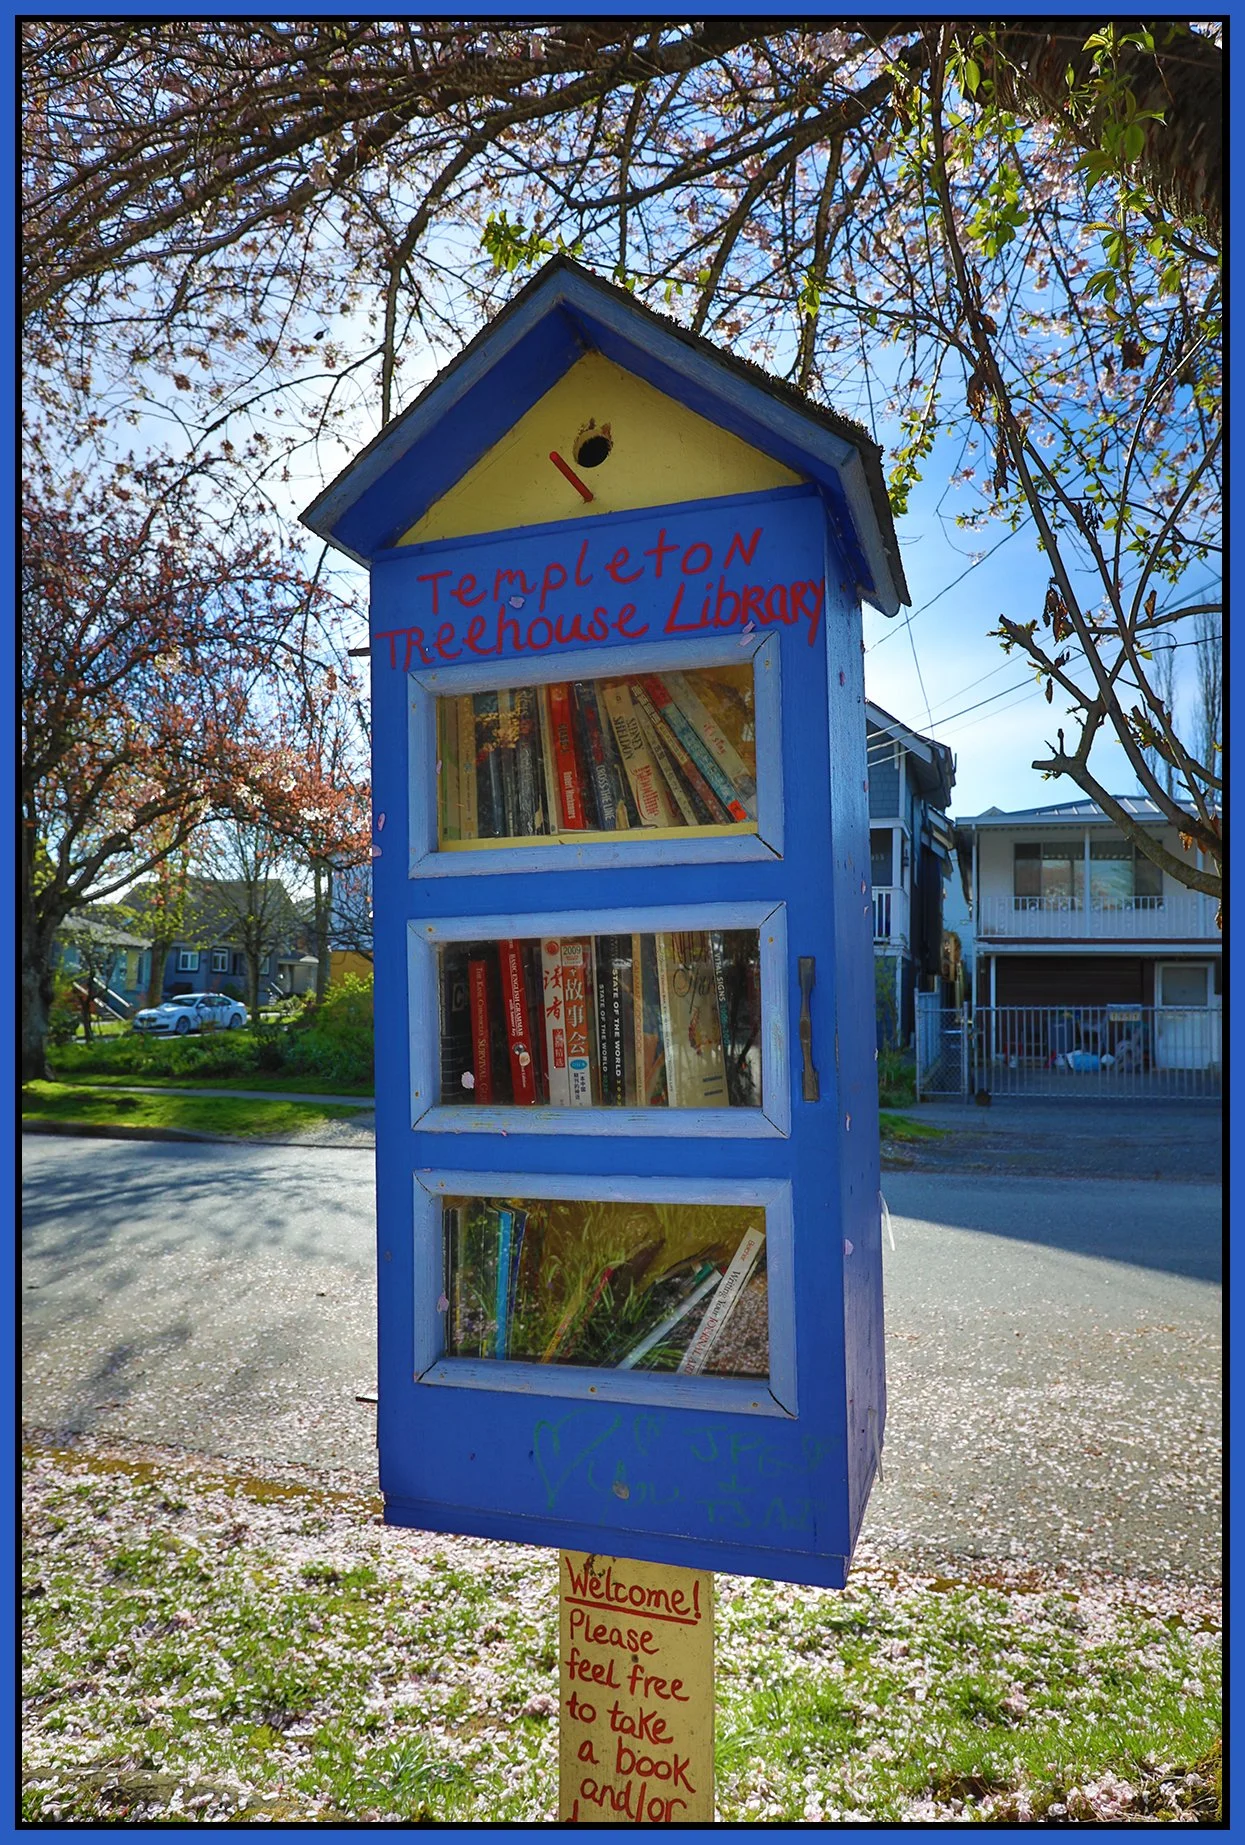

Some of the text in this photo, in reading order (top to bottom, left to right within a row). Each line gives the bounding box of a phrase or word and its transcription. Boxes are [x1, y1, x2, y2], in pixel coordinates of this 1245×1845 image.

[613, 714, 634, 761] SHELDON
[627, 717, 644, 751] SIDNEY
[596, 765, 607, 788] CROSS
[631, 764, 660, 817] Bloodline
[601, 789, 611, 804] THE
[604, 805, 615, 821] LINE
[508, 953, 518, 973] BASIC
[563, 946, 581, 955] 2009
[713, 952, 723, 975] VITAL
[511, 974, 521, 1002] ENGLISH
[543, 963, 563, 1020] 读者
[612, 968, 620, 999] STATE
[716, 977, 725, 1002] SIGNS
[514, 1003, 525, 1037] GRAMMAR
[565, 977, 586, 1055] 故事会
[600, 1010, 606, 1022] OF
[613, 1001, 620, 1016] OF
[477, 1038, 487, 1081] SURVIVAL
[614, 1040, 622, 1077] WORLD
[719, 1270, 741, 1299] Writing
[712, 1299, 727, 1318] Your
[692, 1317, 719, 1357] JOURNAL
[565, 1556, 701, 1619] Welcome!
[569, 1608, 659, 1655] Please
[565, 1647, 690, 1702] feel free
[565, 1691, 674, 1745] to take
[577, 1736, 697, 1794] a book
[579, 1777, 688, 1823] and/or
